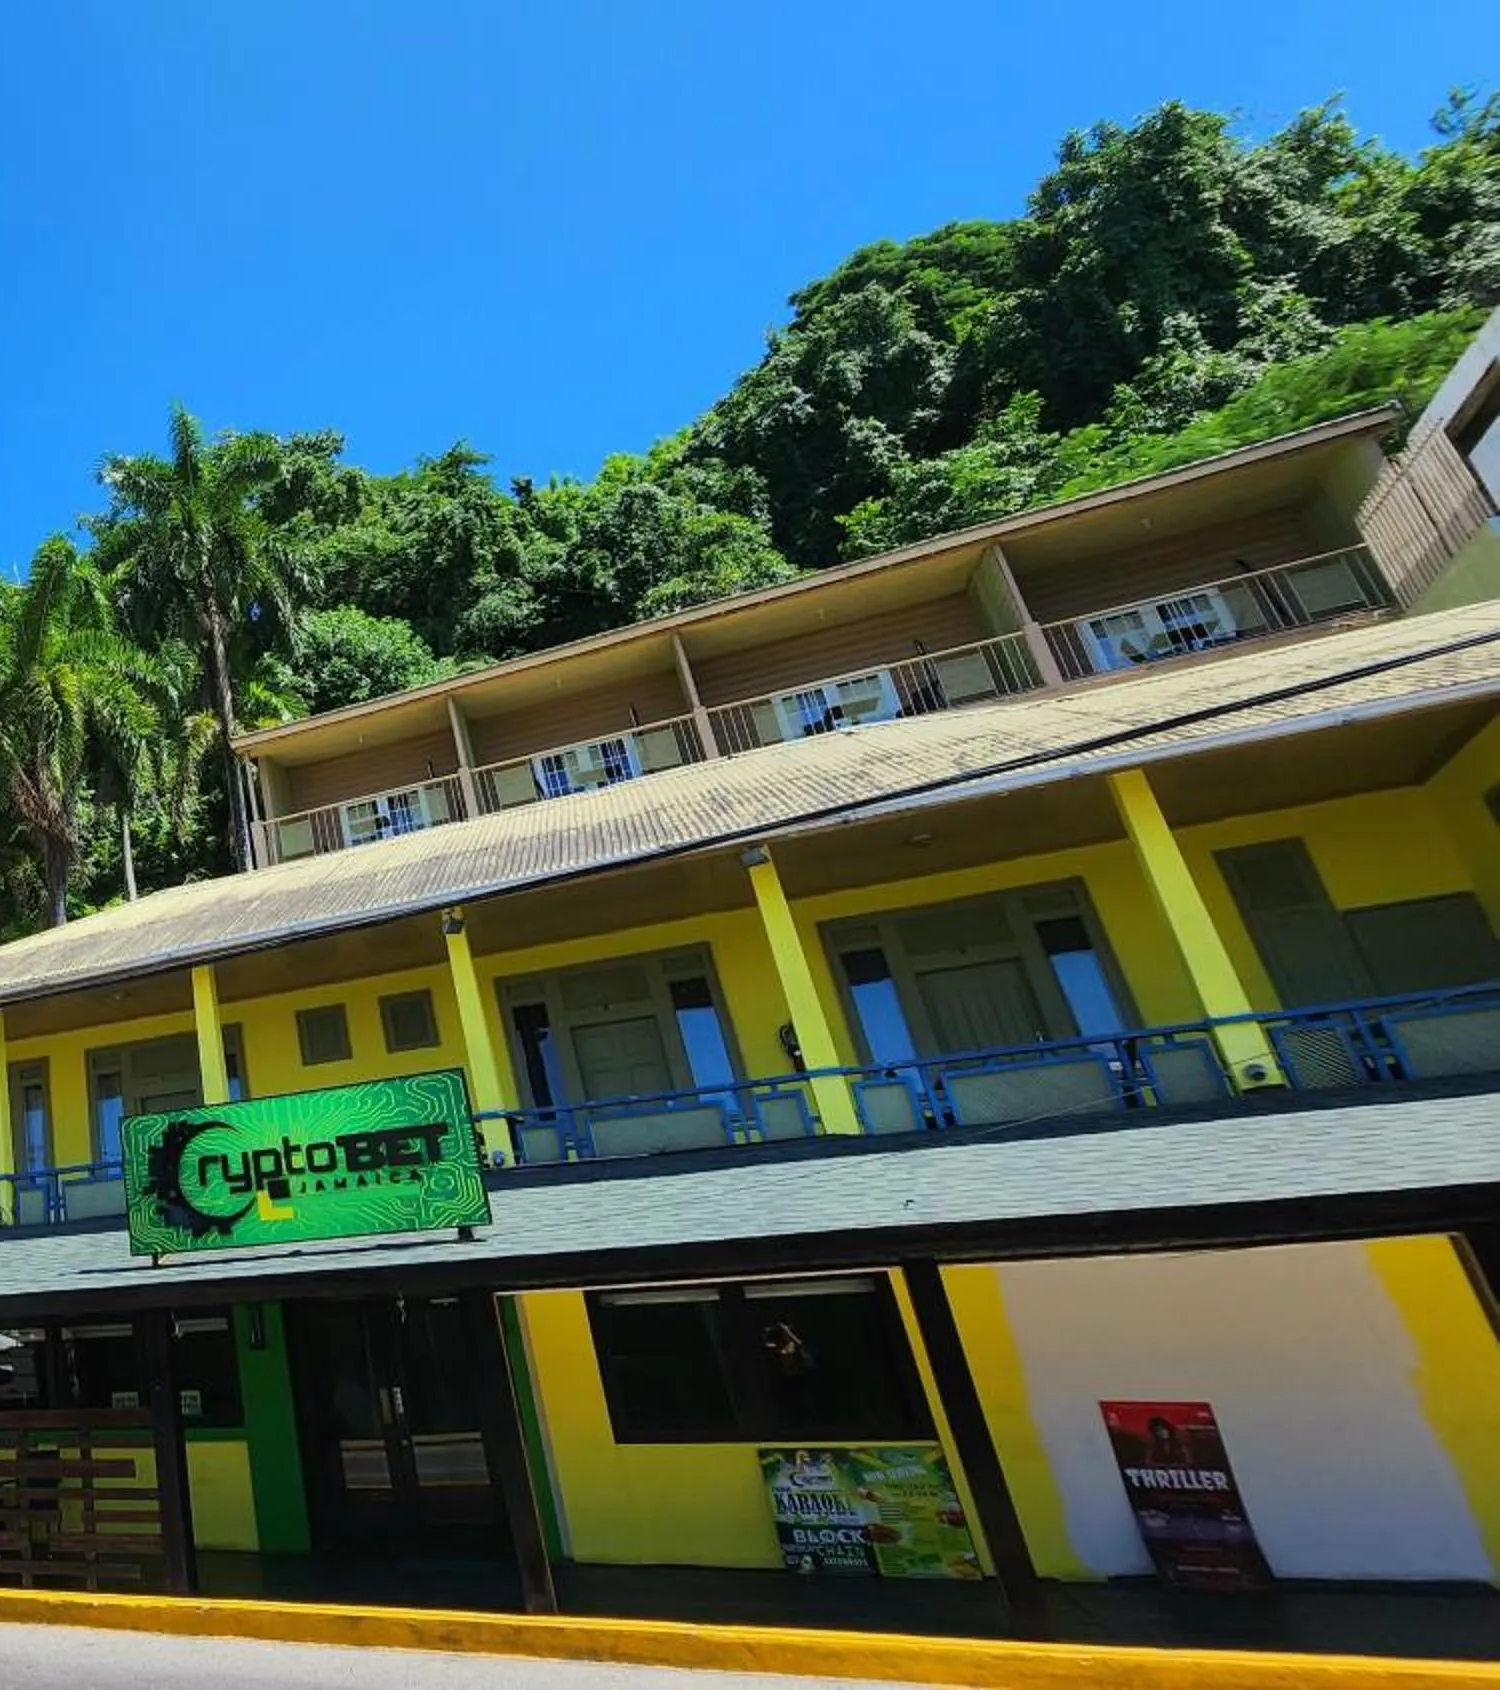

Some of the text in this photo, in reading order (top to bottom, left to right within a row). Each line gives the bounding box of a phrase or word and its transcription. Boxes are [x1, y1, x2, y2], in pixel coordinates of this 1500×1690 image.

[299, 1169, 423, 1196] JAMAICA
[1124, 1468, 1231, 1491] THRILLER
[793, 1527, 866, 1546] BLOCK
